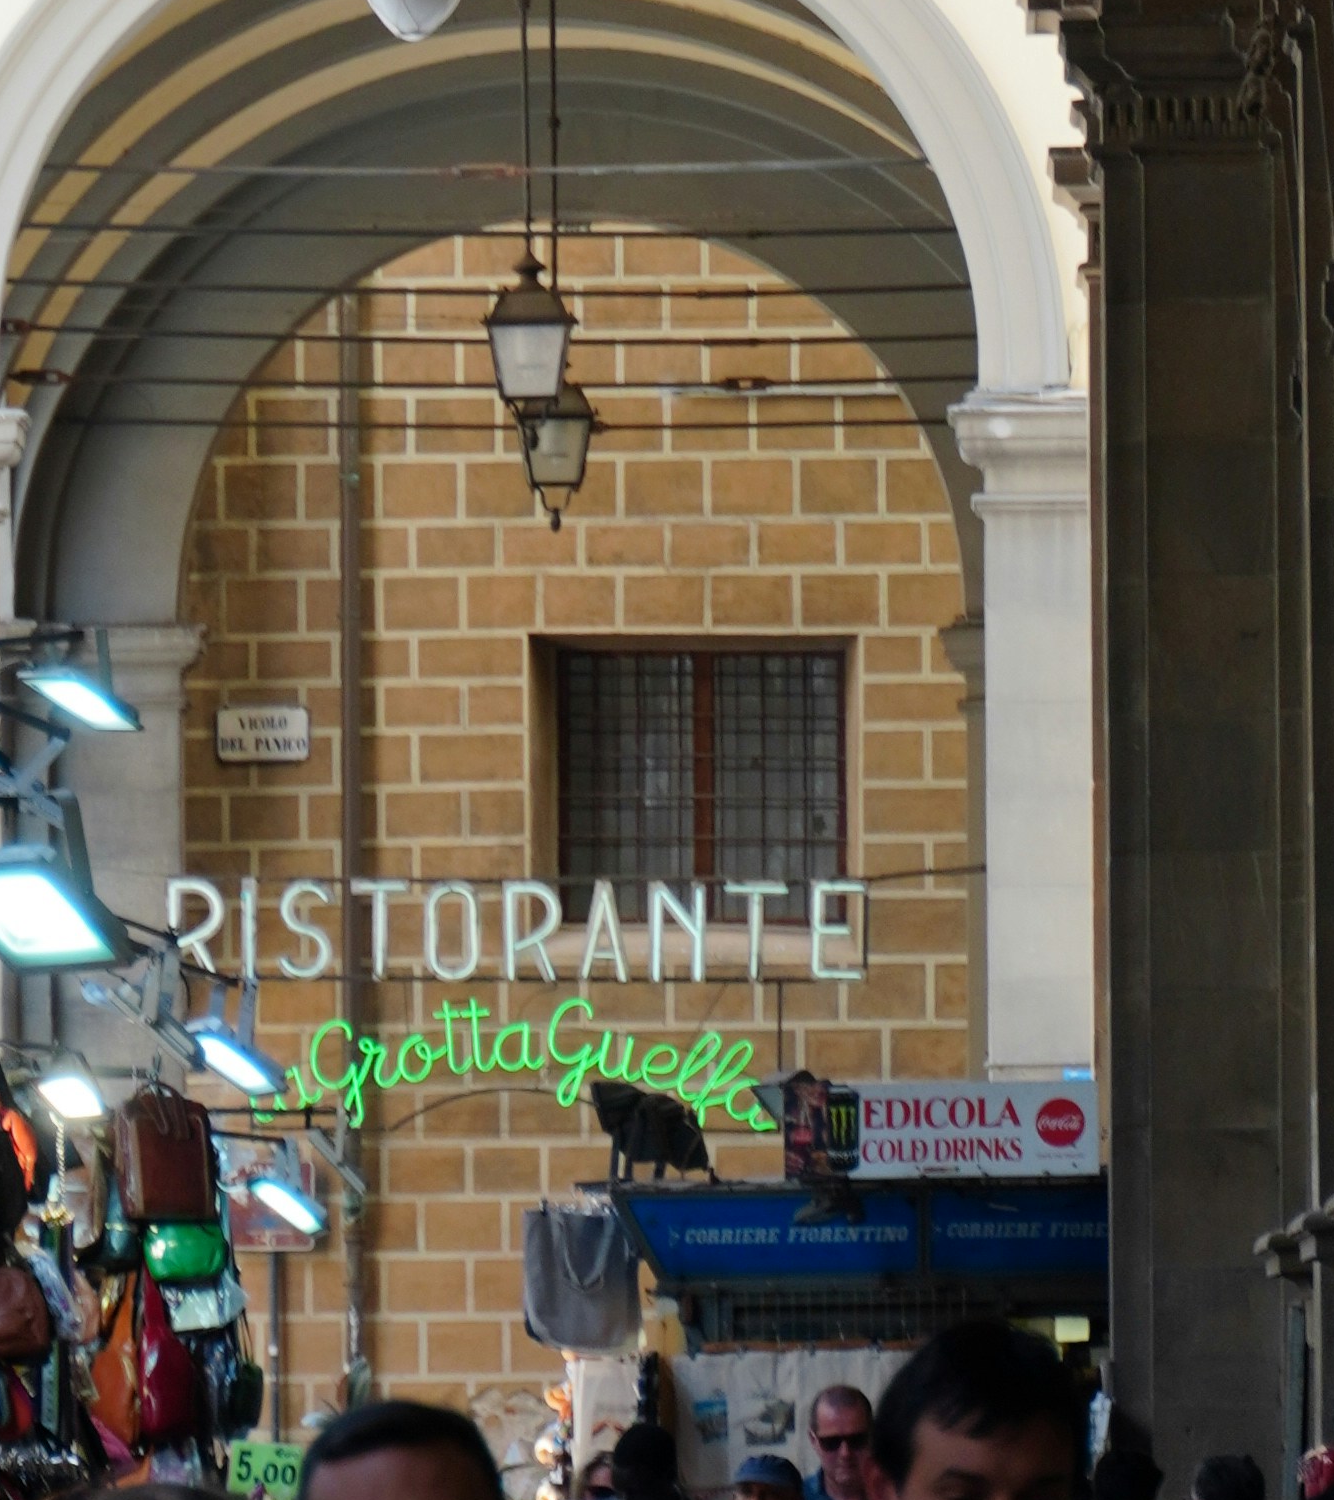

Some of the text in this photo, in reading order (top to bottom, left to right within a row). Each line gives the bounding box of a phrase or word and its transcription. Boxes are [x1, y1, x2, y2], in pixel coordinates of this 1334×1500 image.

[238, 716, 288, 731] VICOLO
[220, 737, 308, 752] DEL PANICO
[167, 878, 865, 983] RISTORANTE
[309, 997, 546, 1129] Grotta
[547, 997, 778, 1132] Guelfa
[863, 1096, 1021, 1130] EDICOLA
[862, 1138, 928, 1164] COLD
[934, 1137, 1023, 1163] DRINKS
[685, 1225, 908, 1245] CORRIERE FIORENTINO
[946, 1221, 1109, 1239] CORRIERE FIORE
